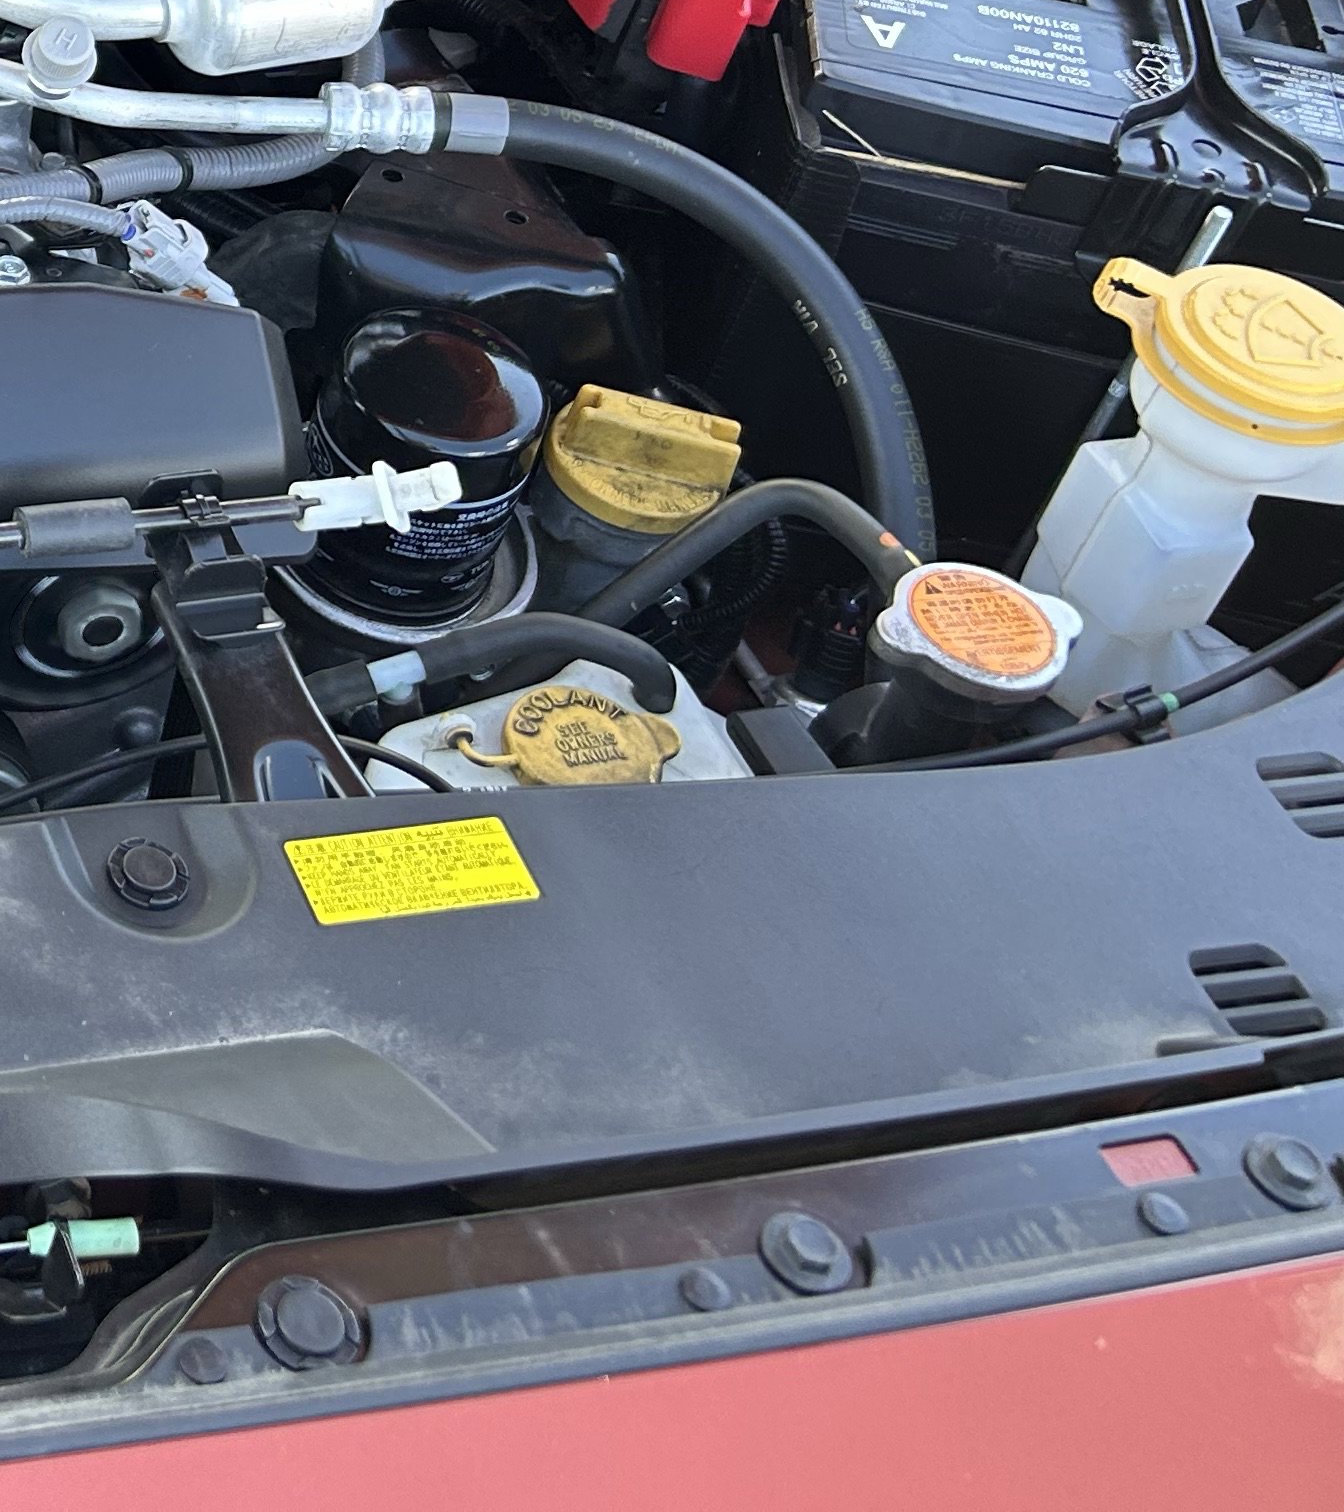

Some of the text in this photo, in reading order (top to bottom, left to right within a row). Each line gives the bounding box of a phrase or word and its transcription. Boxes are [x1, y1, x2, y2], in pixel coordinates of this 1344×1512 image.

[54, 28, 78, 50] H
[1052, 41, 1085, 56] LN2
[1008, 53, 1089, 78] 620 AMPS
[1042, 51, 1087, 65] GROUP
[953, 53, 1091, 88] COLD CRANKING AMPS
[514, 689, 627, 736] COOLANT
[556, 721, 588, 738] SEE
[562, 748, 629, 768] MANUAL
[327, 838, 365, 853] CAUTION
[367, 831, 413, 848] ATTENTION
